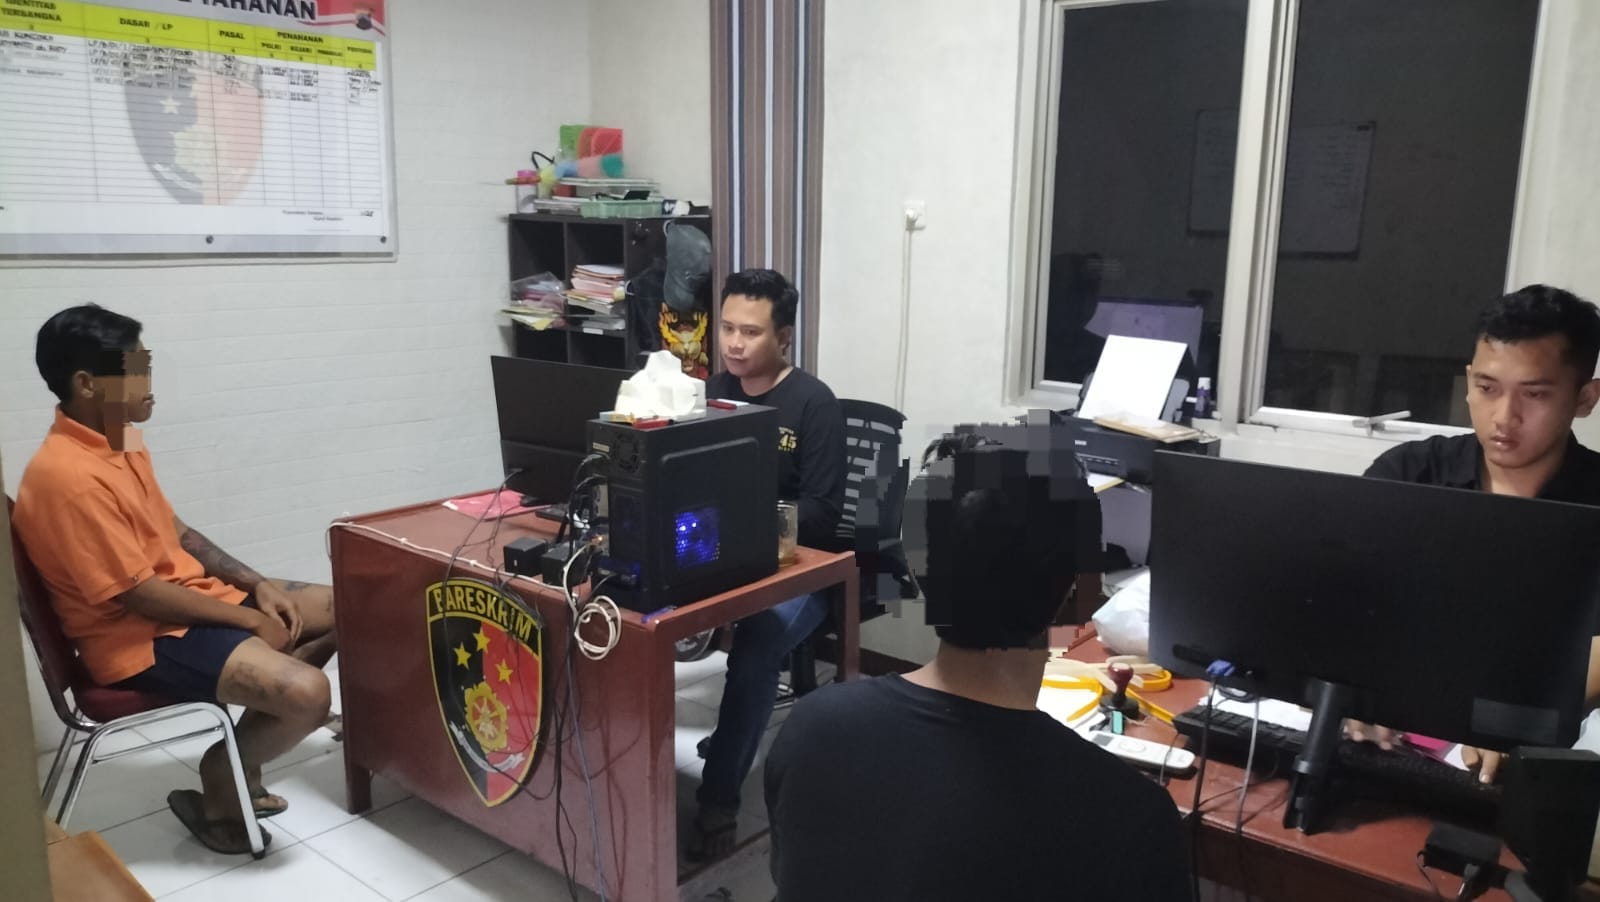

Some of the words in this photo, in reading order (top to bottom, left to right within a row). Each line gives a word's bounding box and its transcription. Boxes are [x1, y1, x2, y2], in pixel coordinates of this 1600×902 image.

[1, 7, 62, 22] TERSANGKA
[201, 0, 316, 20] HANAN
[119, 17, 150, 28] DASAR
[162, 23, 173, 31] LP
[219, 30, 245, 40] PASAL
[277, 31, 323, 43] PENAHANAN
[780, 434, 797, 449] 45
